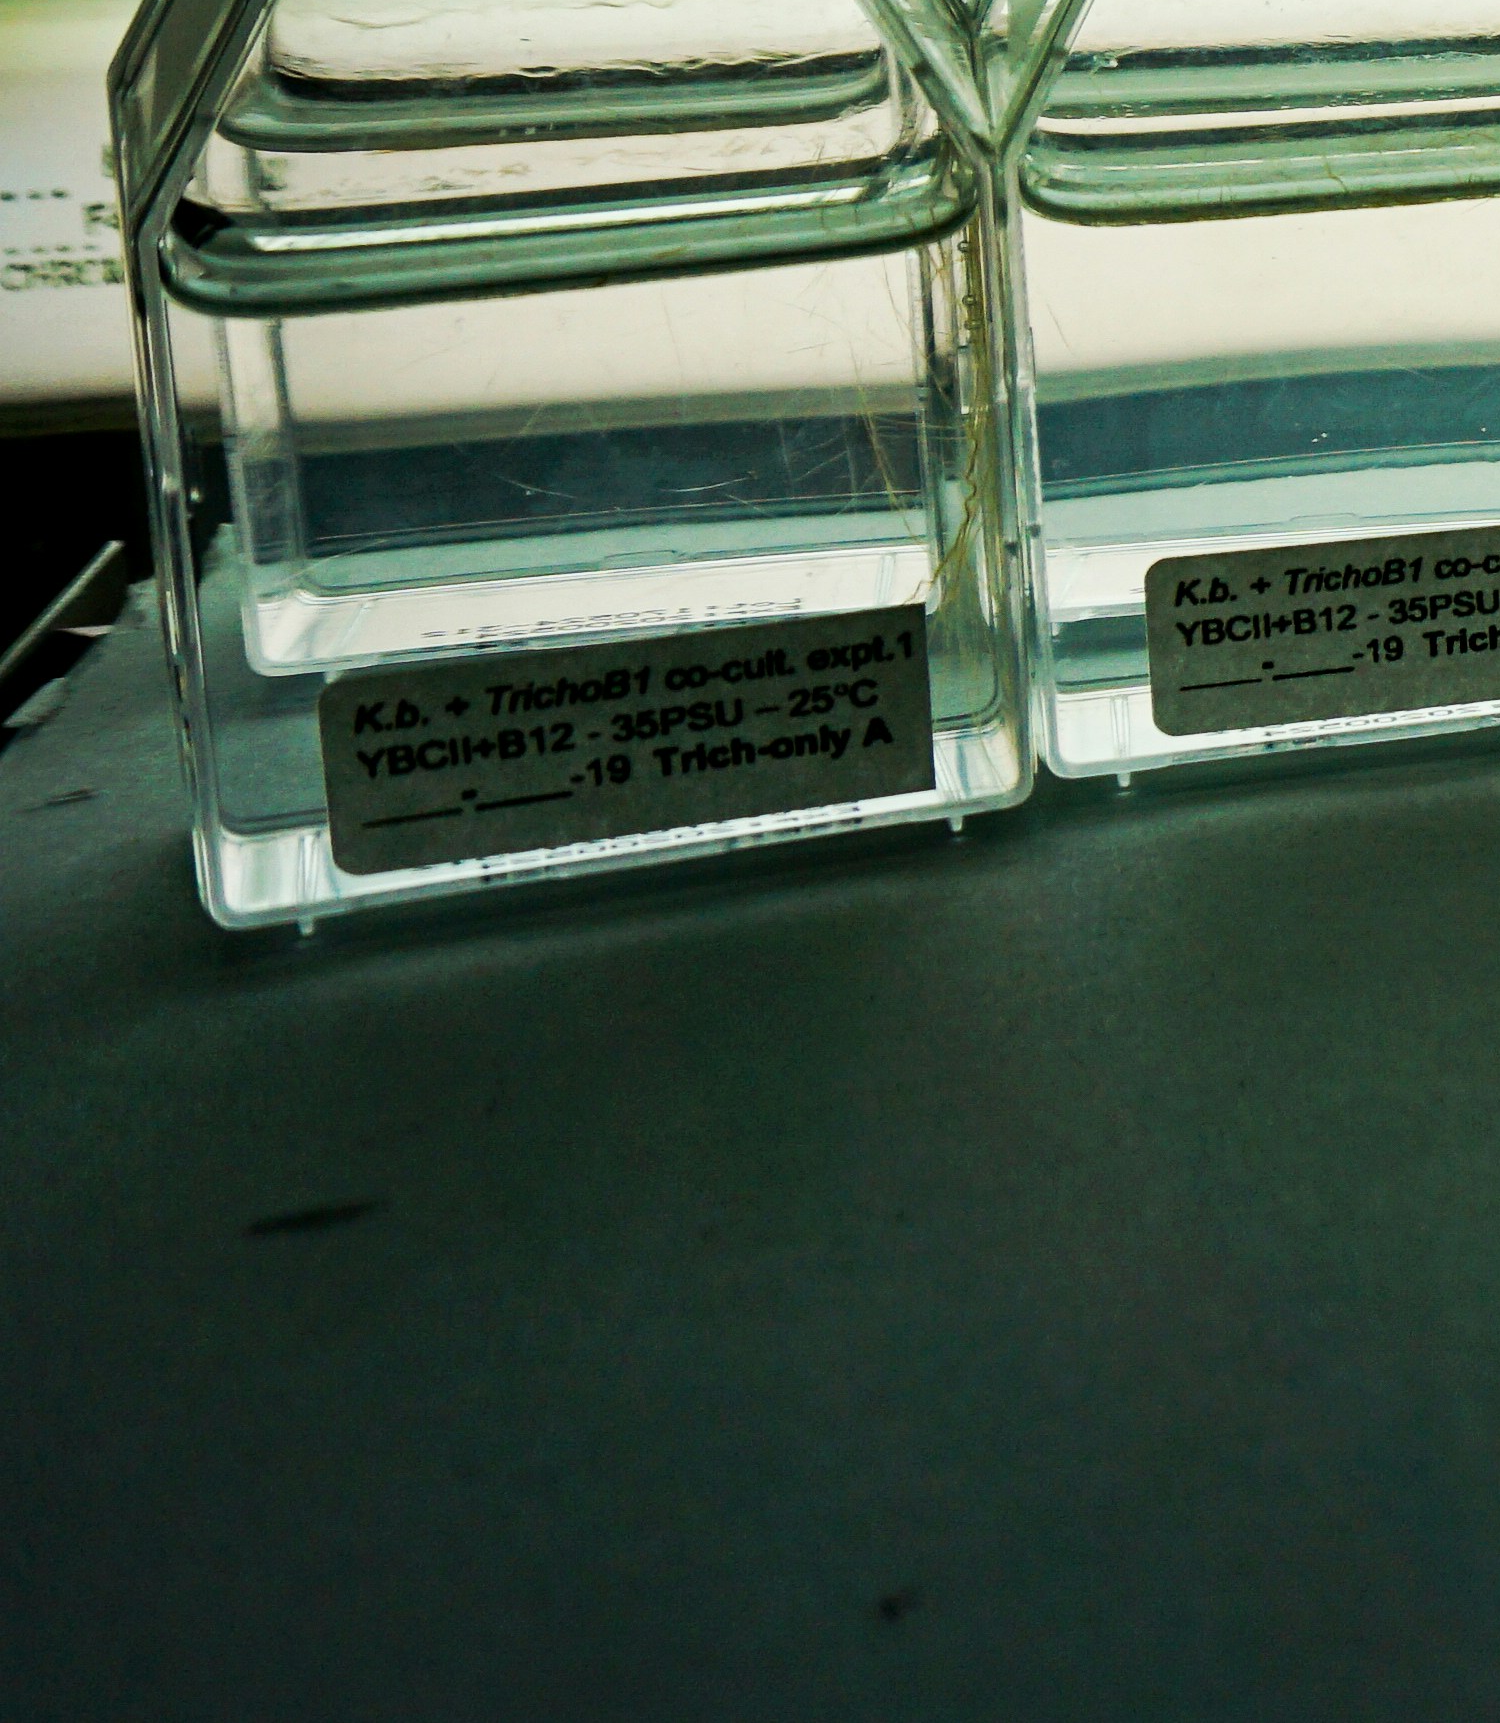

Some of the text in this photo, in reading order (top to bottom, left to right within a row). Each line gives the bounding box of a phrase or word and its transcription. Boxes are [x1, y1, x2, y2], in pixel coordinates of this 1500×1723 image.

[1174, 577, 1238, 607] K.b.
[1250, 576, 1271, 595] +
[1284, 556, 1424, 596] TrichoB1
[1388, 589, 1500, 625] 35PSU
[354, 699, 431, 735] K.b.
[445, 695, 470, 717] +
[485, 665, 650, 716] TrichoB1
[610, 697, 744, 743] 35PSU
[652, 723, 851, 776] Trich-only
[862, 716, 894, 748] A
